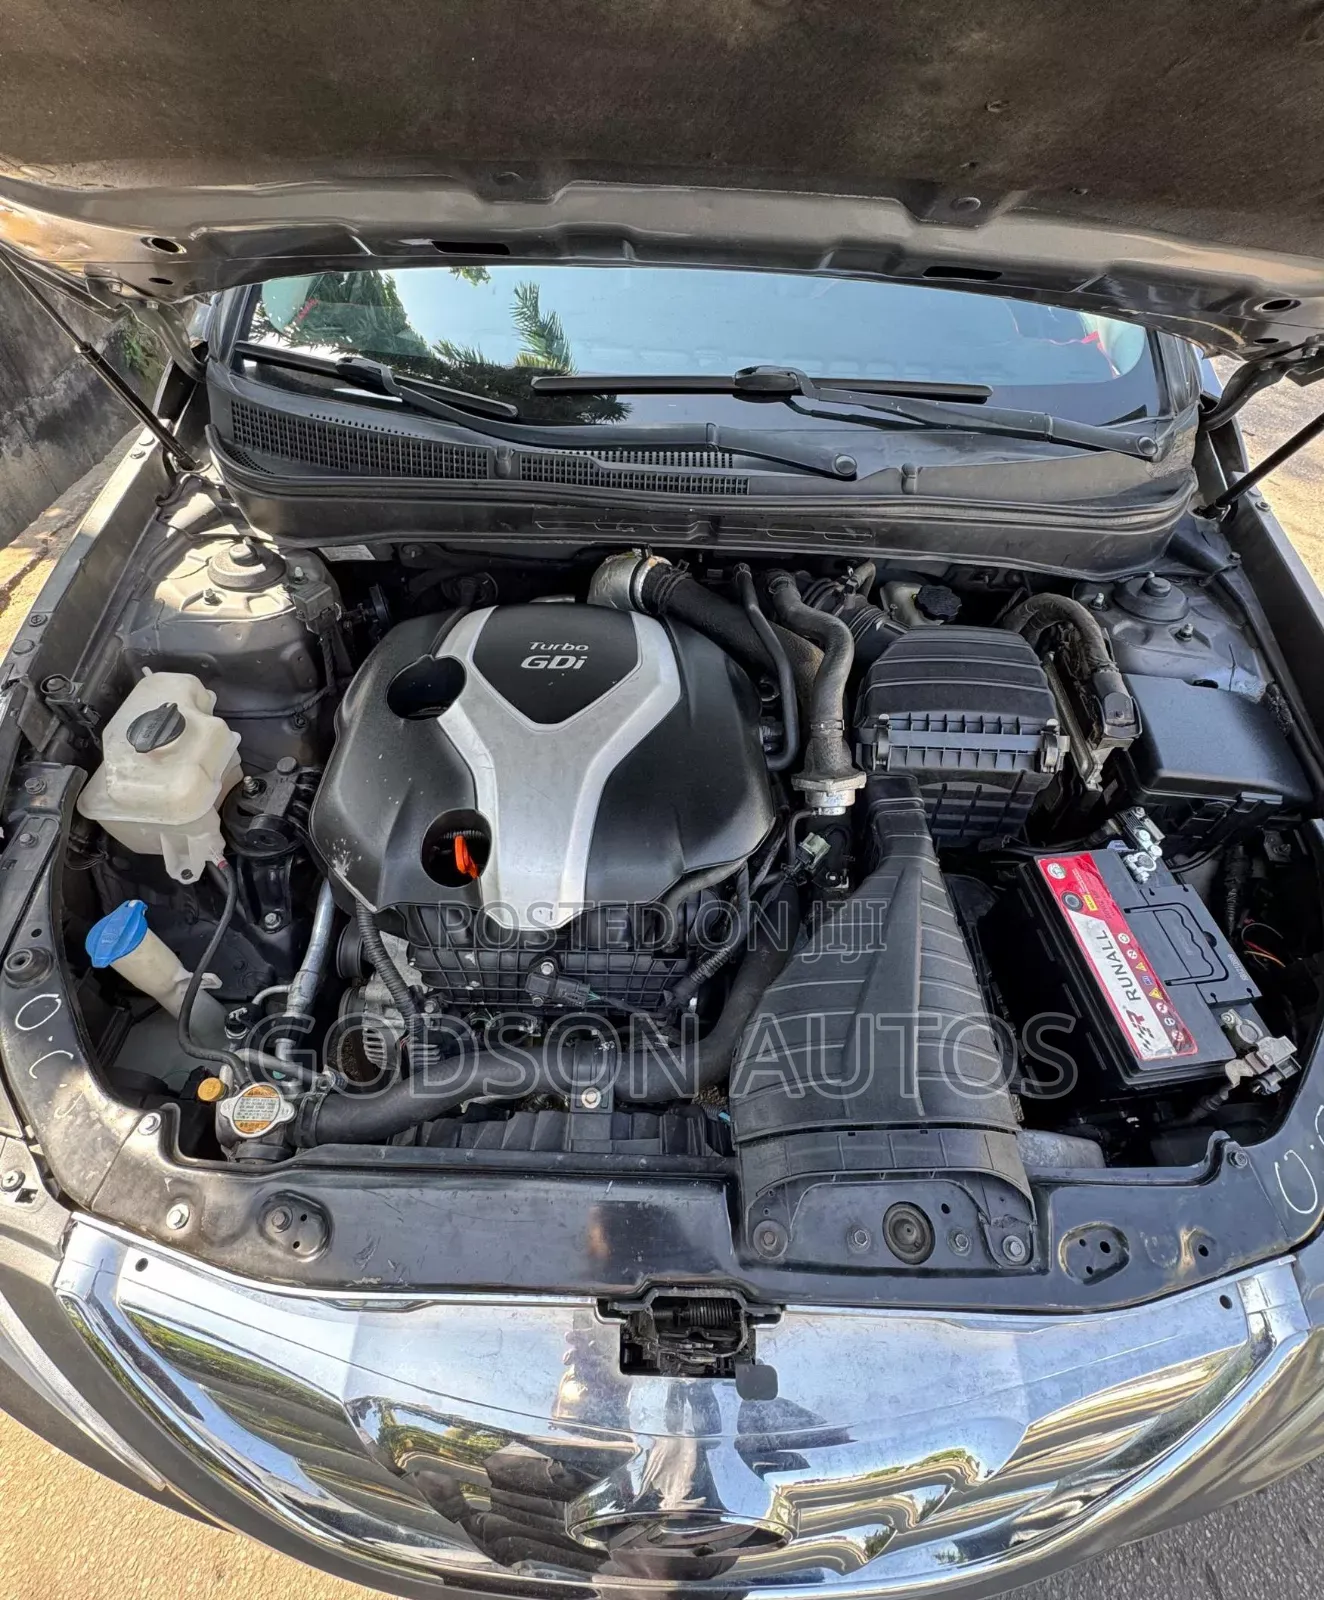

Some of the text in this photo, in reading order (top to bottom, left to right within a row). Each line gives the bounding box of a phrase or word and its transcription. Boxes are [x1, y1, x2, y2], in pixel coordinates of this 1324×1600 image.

[529, 641, 589, 651] Turbo
[520, 655, 588, 669] GDi
[1096, 929, 1141, 1001] RUNALL
